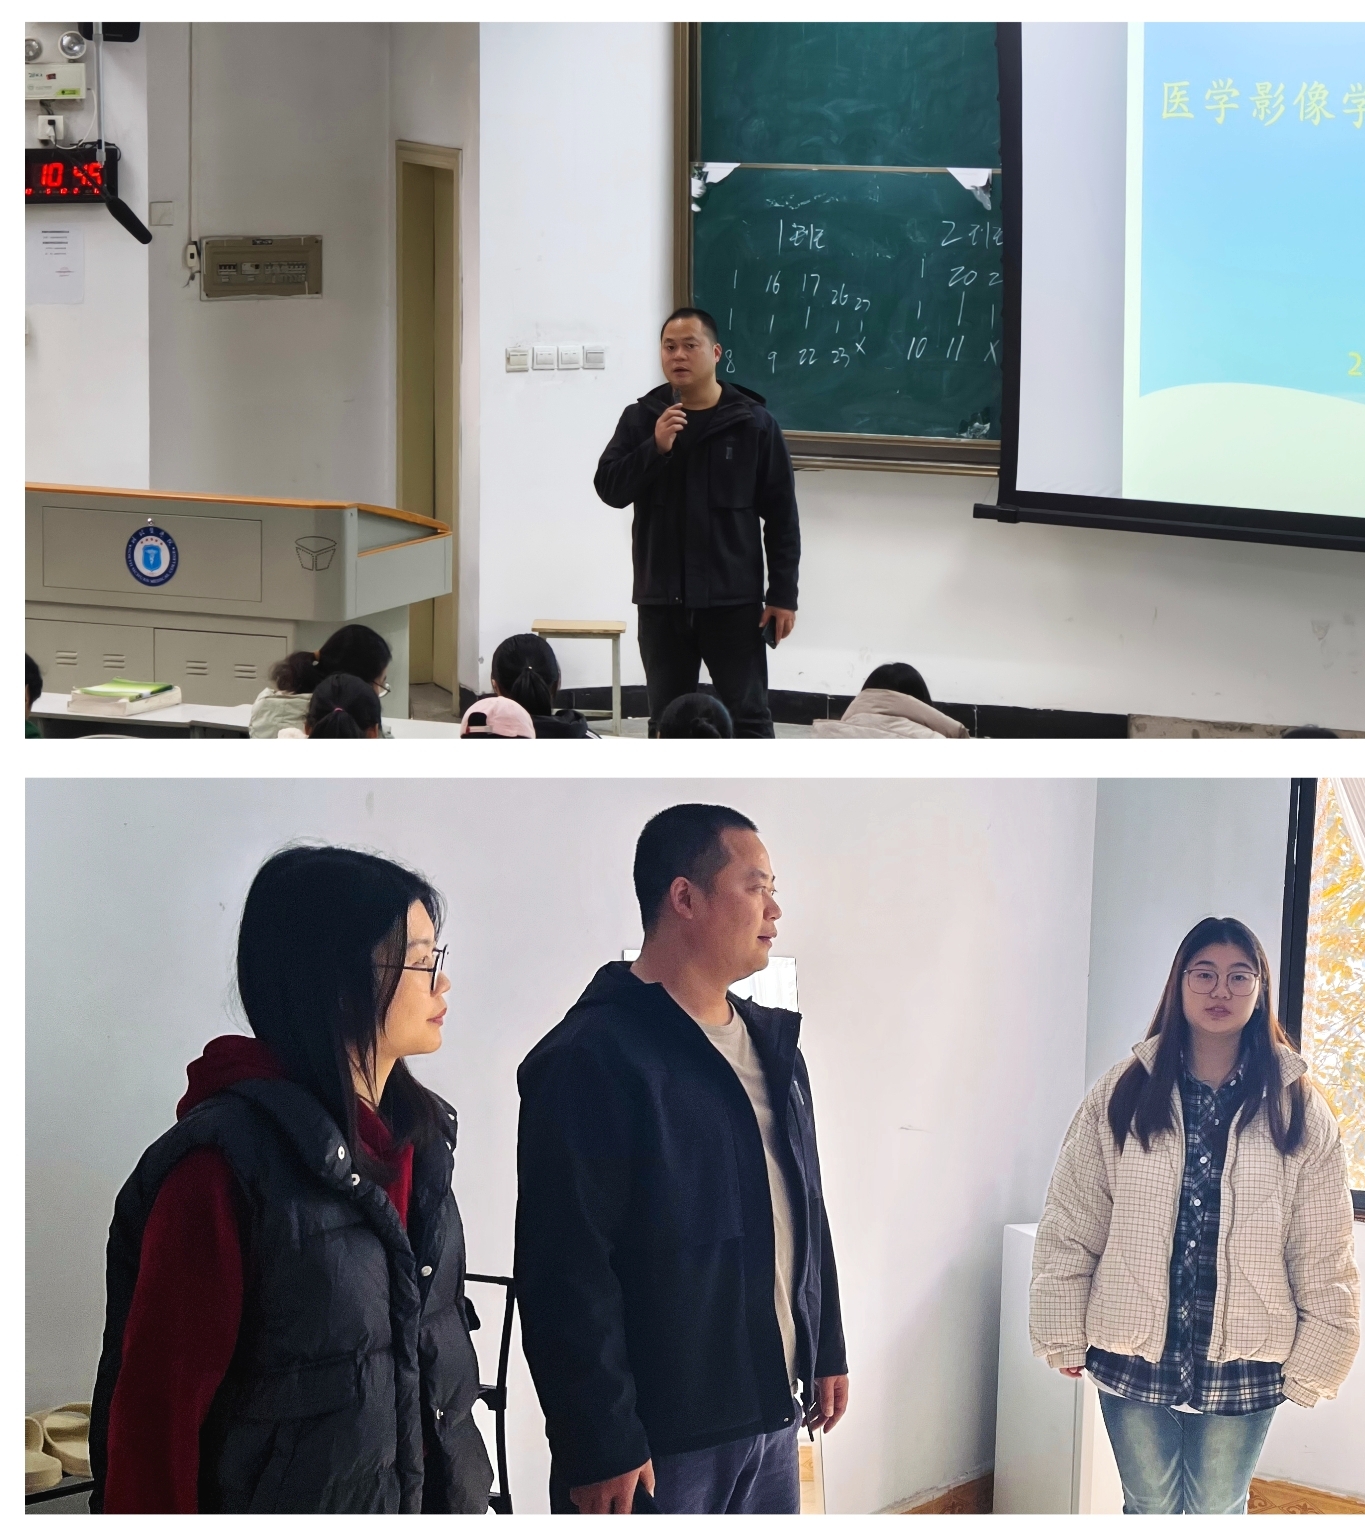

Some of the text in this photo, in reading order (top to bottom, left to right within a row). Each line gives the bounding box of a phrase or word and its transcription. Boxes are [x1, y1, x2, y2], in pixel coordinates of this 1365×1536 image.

[41, 162, 64, 187] 10
[765, 270, 781, 294] 16
[802, 273, 821, 296] 17
[948, 266, 978, 287] 20
[831, 283, 849, 306] 26
[799, 348, 819, 366] 22
[831, 347, 850, 368] 23
[907, 336, 929, 361] 10
[946, 335, 965, 362] 11
[725, 350, 735, 373] 8
[767, 351, 778, 374] 9
